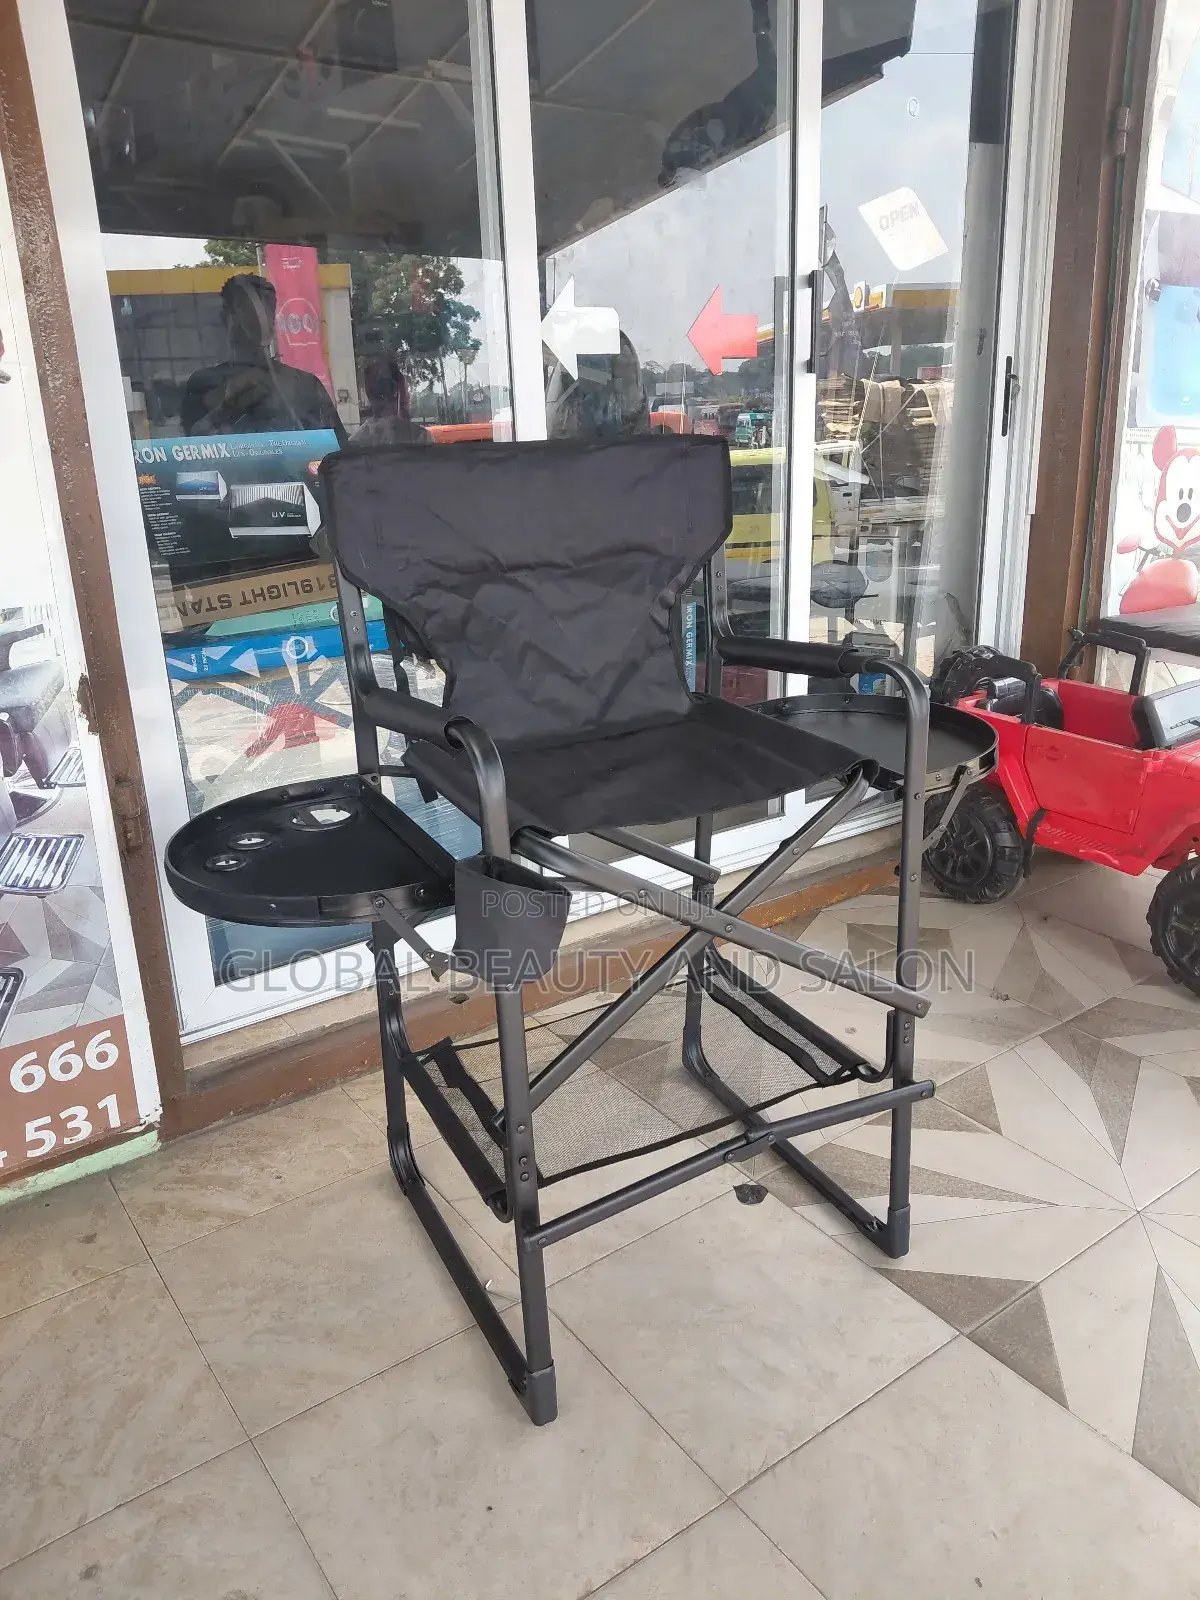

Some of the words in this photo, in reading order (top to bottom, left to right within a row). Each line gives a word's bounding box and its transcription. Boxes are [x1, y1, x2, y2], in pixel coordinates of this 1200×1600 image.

[878, 200, 920, 232] OPEN
[171, 441, 231, 462] GERMIX
[685, 605, 693, 629] IRON
[685, 631, 694, 667] GERMIX
[9, 1029, 119, 1093] 666
[25, 1093, 121, 1158] 531
